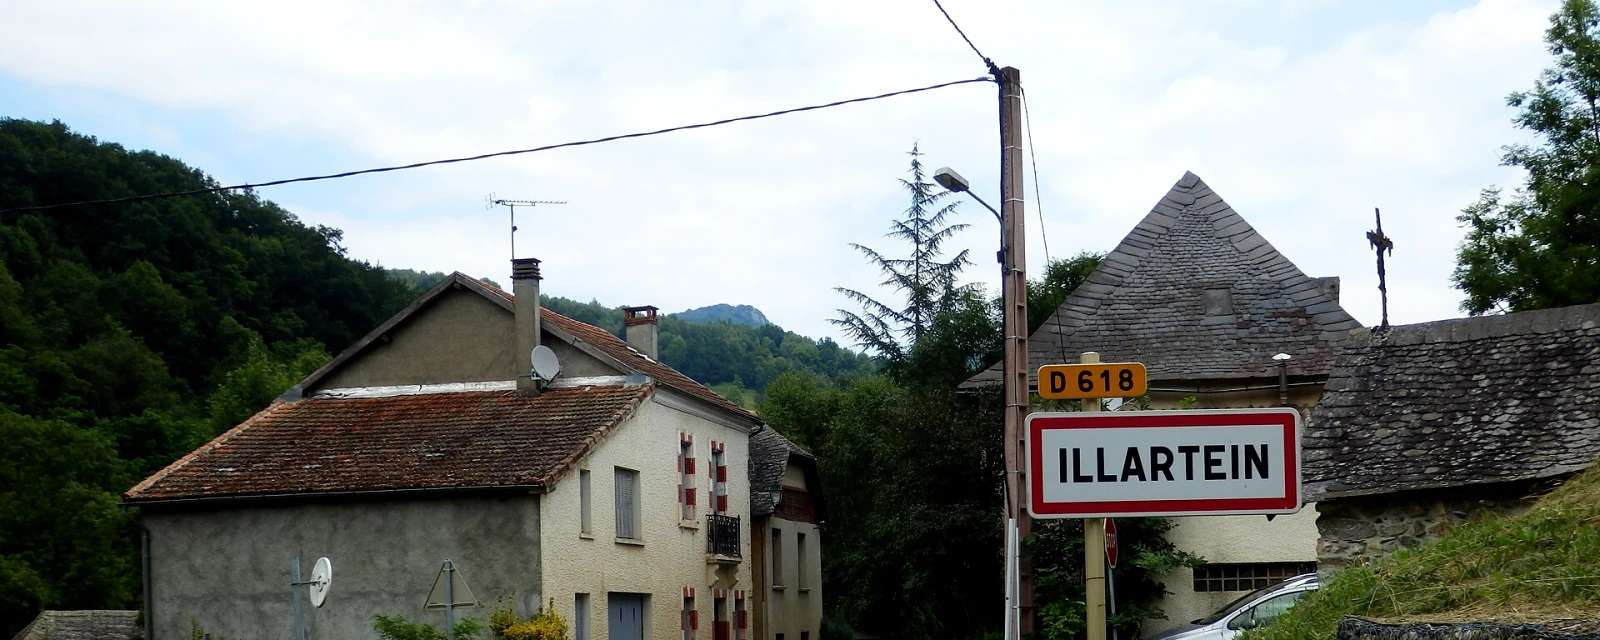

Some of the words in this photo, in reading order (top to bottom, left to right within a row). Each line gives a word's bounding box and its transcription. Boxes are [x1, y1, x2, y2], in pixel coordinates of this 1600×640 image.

[1050, 371, 1066, 393] D
[1078, 369, 1134, 392] 618
[1059, 444, 1269, 483] ILLARTEIN
